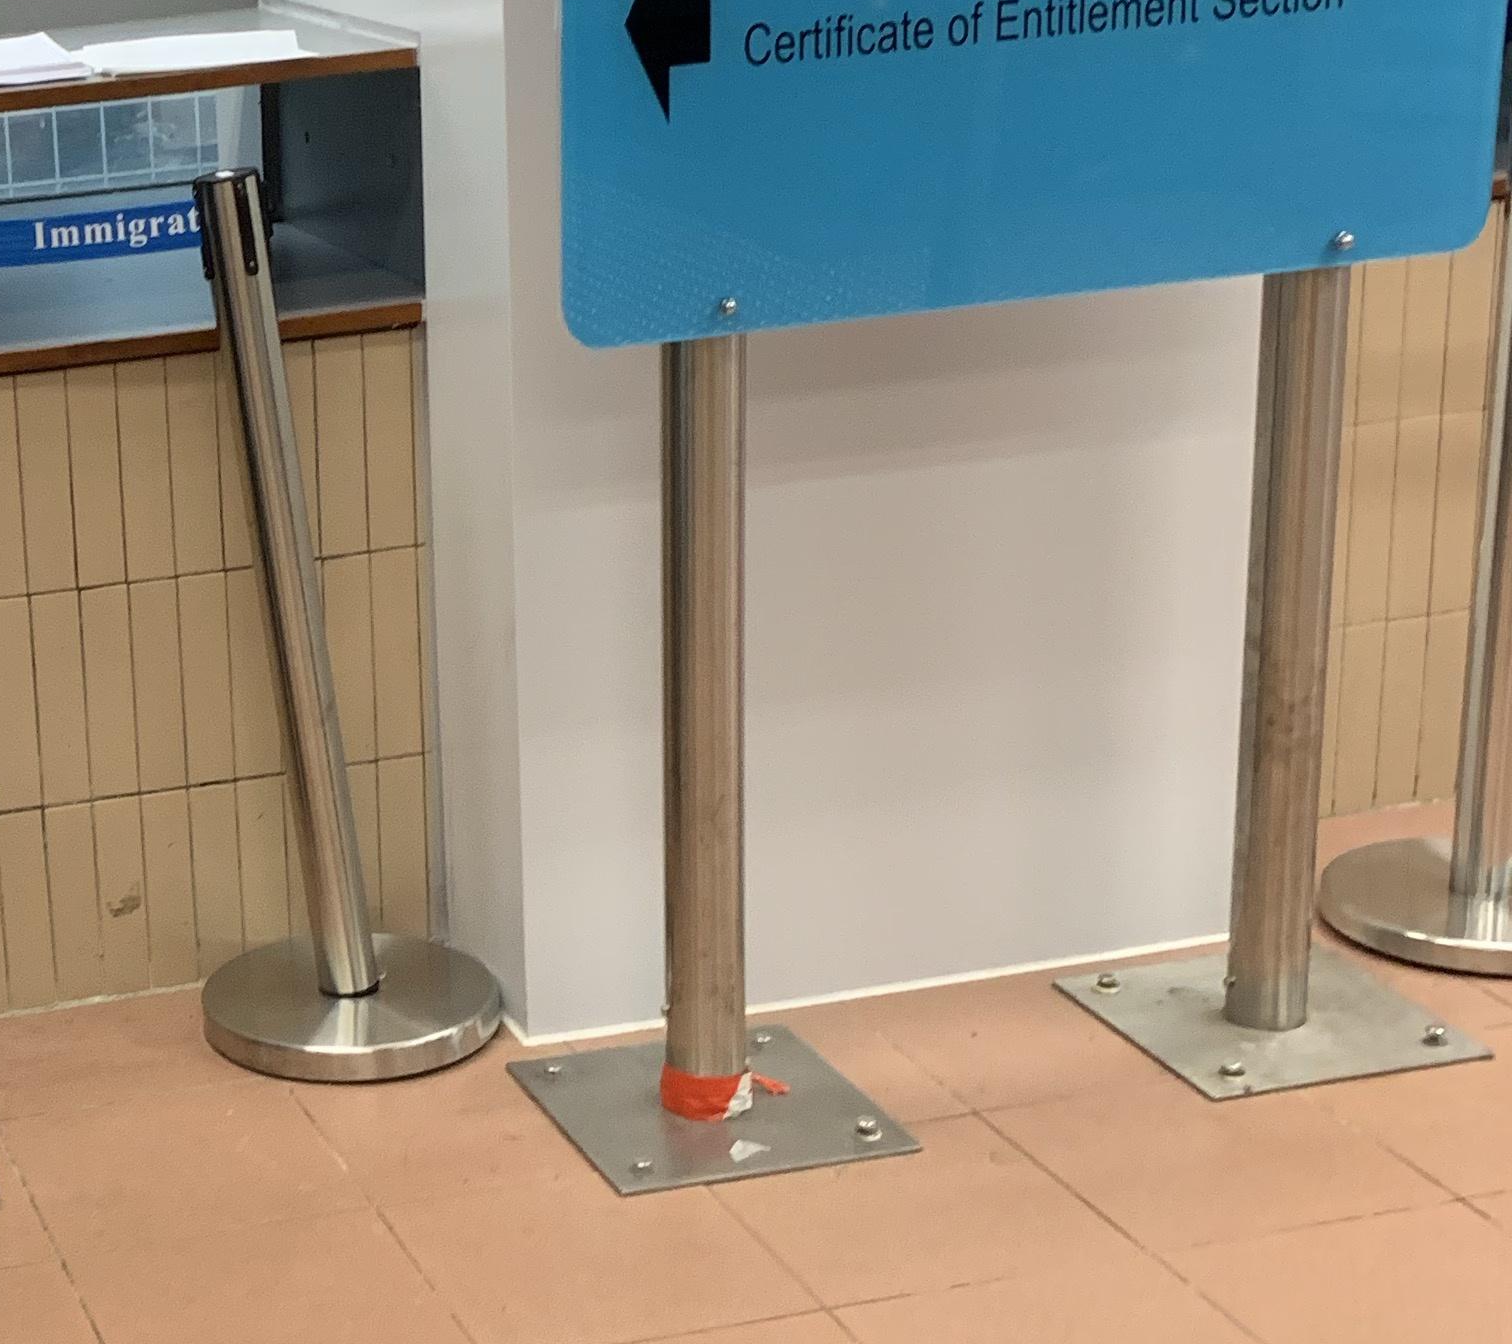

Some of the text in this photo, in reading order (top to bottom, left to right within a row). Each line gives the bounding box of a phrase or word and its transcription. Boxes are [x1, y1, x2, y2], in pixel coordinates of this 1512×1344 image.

[743, 10, 935, 67] Certificate
[947, 0, 985, 47] of
[33, 205, 202, 250] Immigrat
